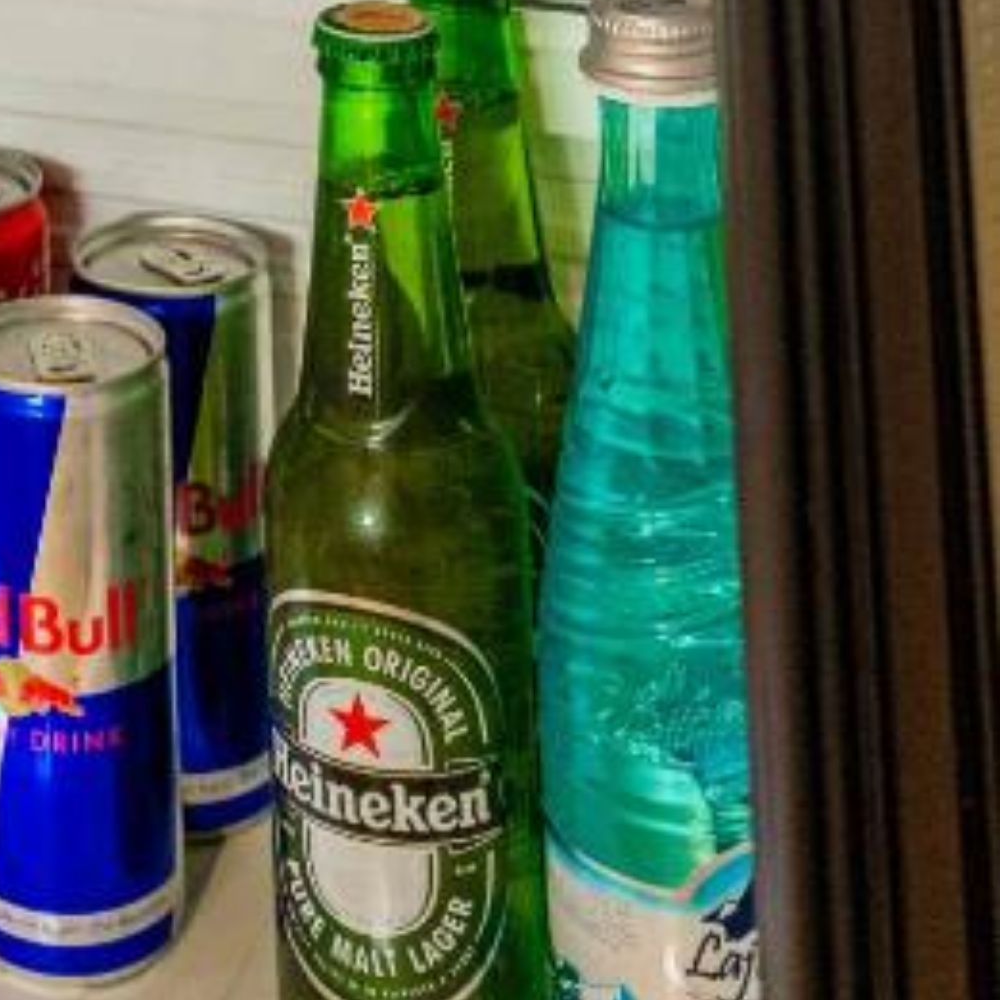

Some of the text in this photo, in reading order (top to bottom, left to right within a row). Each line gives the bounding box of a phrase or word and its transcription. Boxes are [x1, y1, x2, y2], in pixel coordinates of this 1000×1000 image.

[346, 243, 374, 398] Heineken
[20, 580, 138, 655] Bull
[363, 645, 469, 745] ORIGINAL
[271, 726, 492, 834] Heineken
[329, 932, 397, 978] MALT
[406, 896, 474, 974] LAGER
